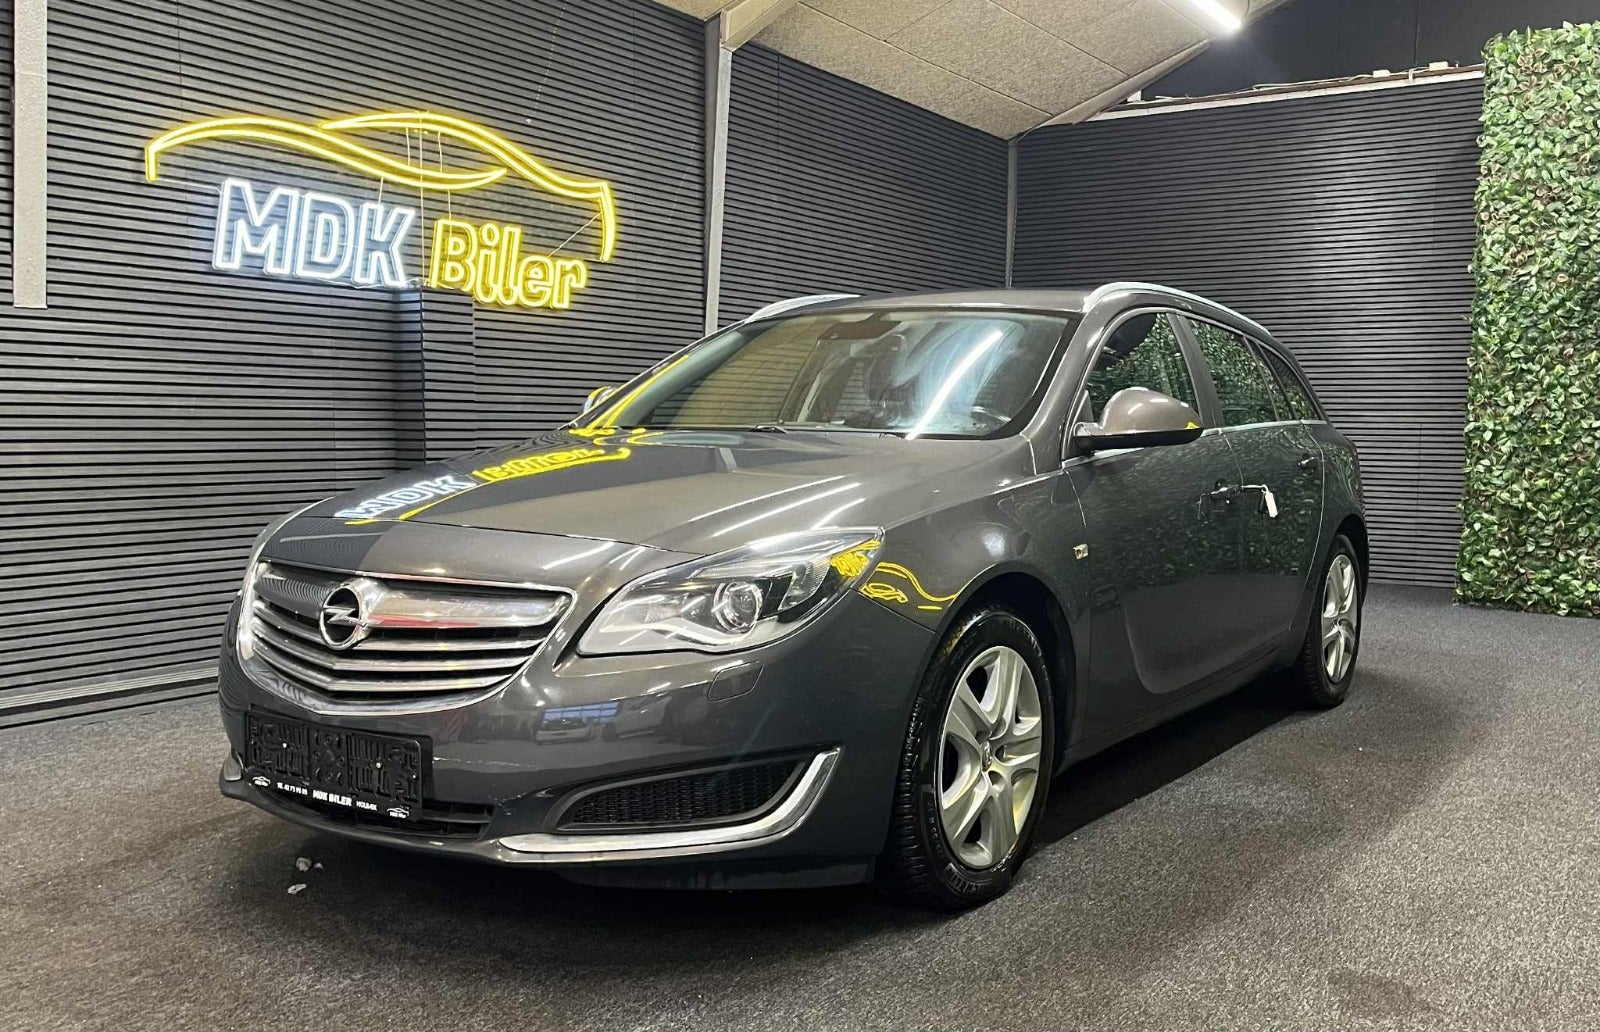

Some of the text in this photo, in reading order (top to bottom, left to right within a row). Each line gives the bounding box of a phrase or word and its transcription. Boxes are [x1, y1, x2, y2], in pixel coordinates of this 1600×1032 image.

[212, 178, 589, 310] MDK Biler
[328, 793, 352, 807] BILER
